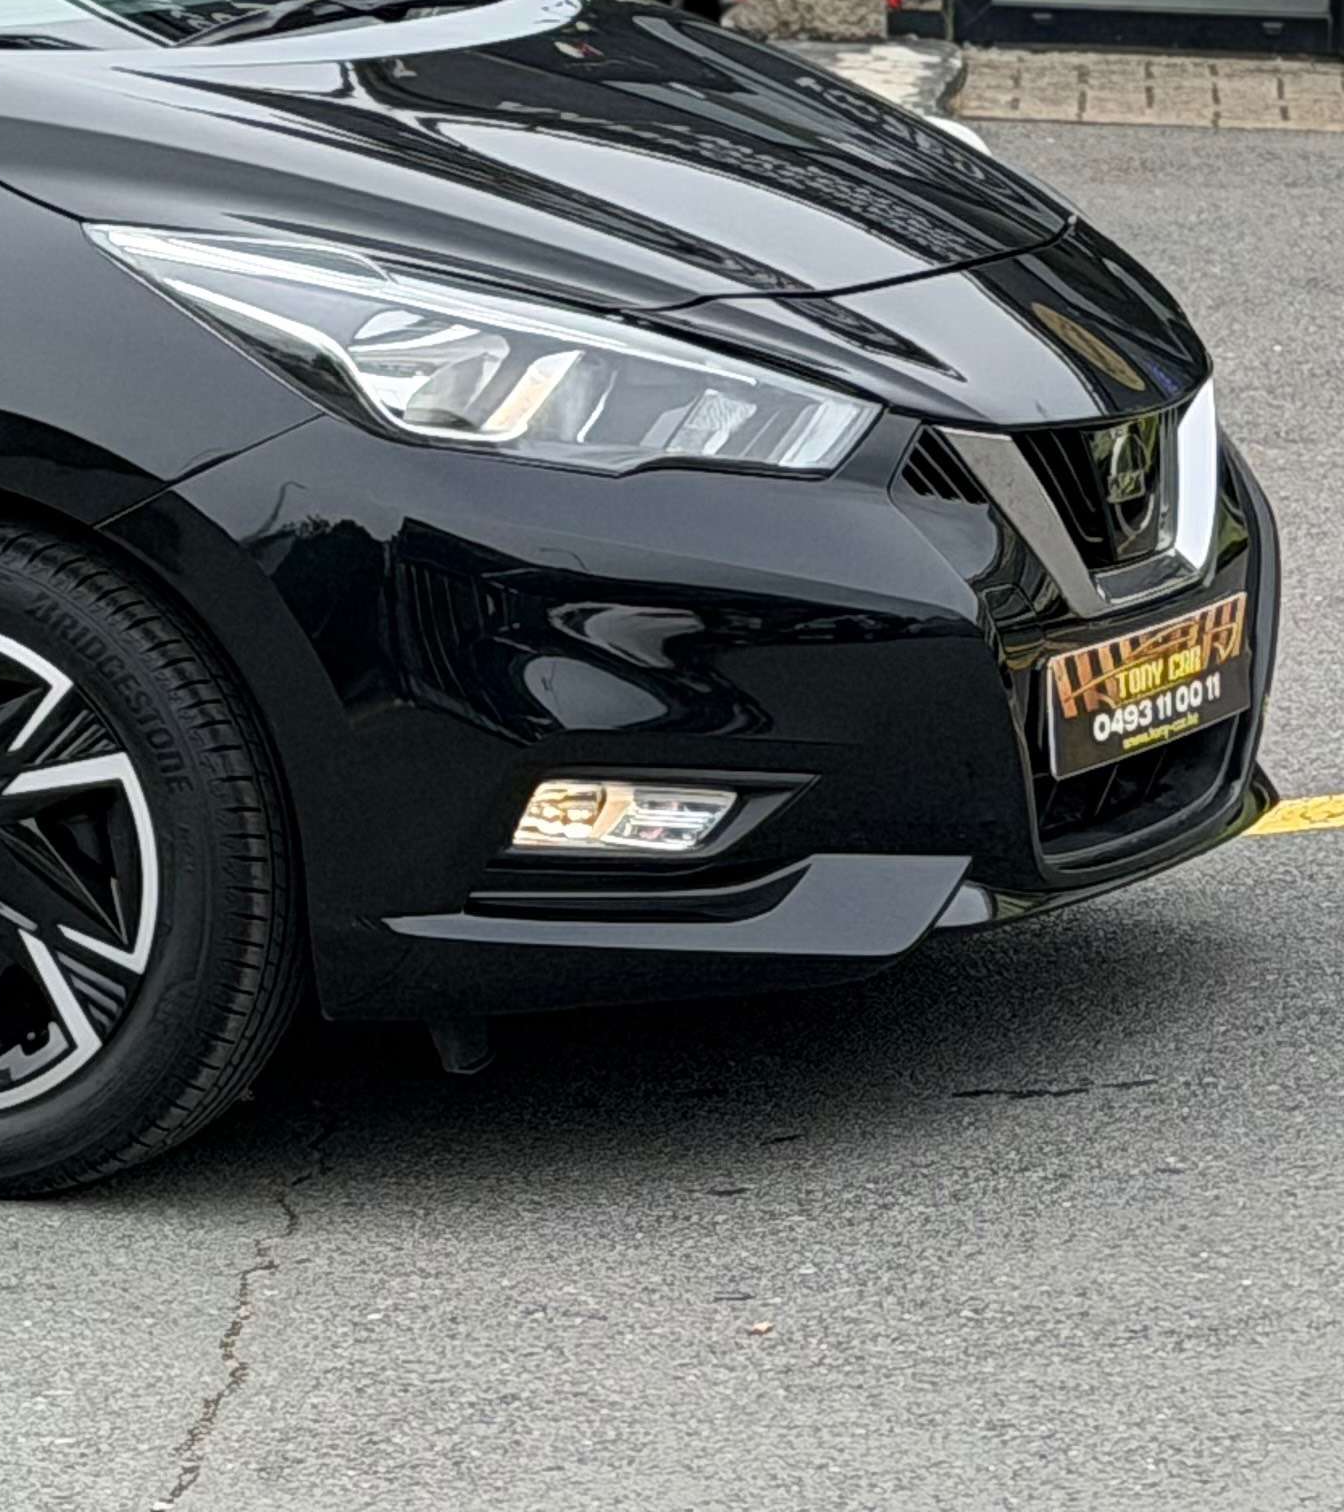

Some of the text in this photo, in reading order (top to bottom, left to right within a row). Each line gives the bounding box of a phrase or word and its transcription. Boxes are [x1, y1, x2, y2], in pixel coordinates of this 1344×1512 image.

[23, 593, 194, 795] BRIDGESTONE
[1116, 644, 1202, 698] TONY CAR
[1093, 672, 1221, 742] 0493 11 00 11
